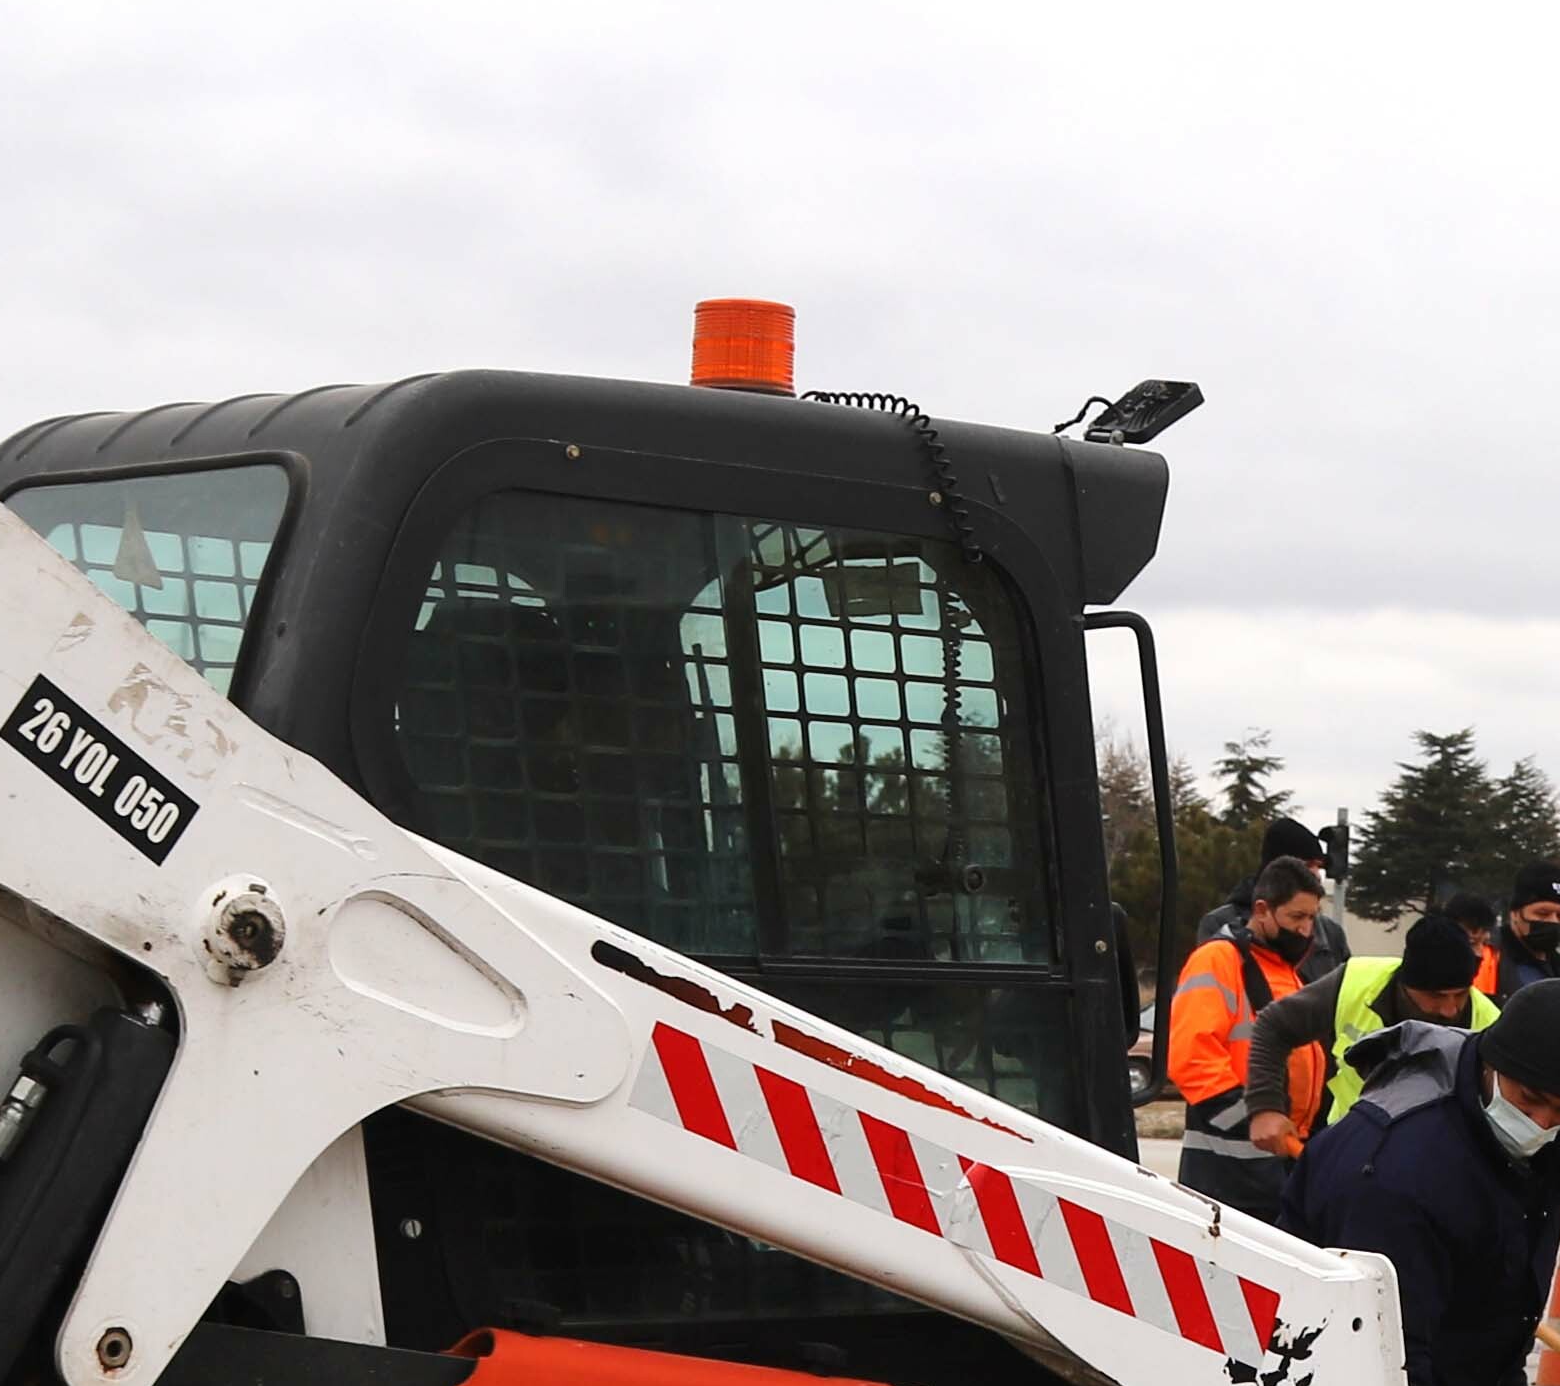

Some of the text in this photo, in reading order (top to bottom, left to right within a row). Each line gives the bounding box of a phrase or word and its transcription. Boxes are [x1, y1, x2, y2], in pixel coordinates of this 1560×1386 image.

[17, 697, 181, 846] 26 YOL 050
